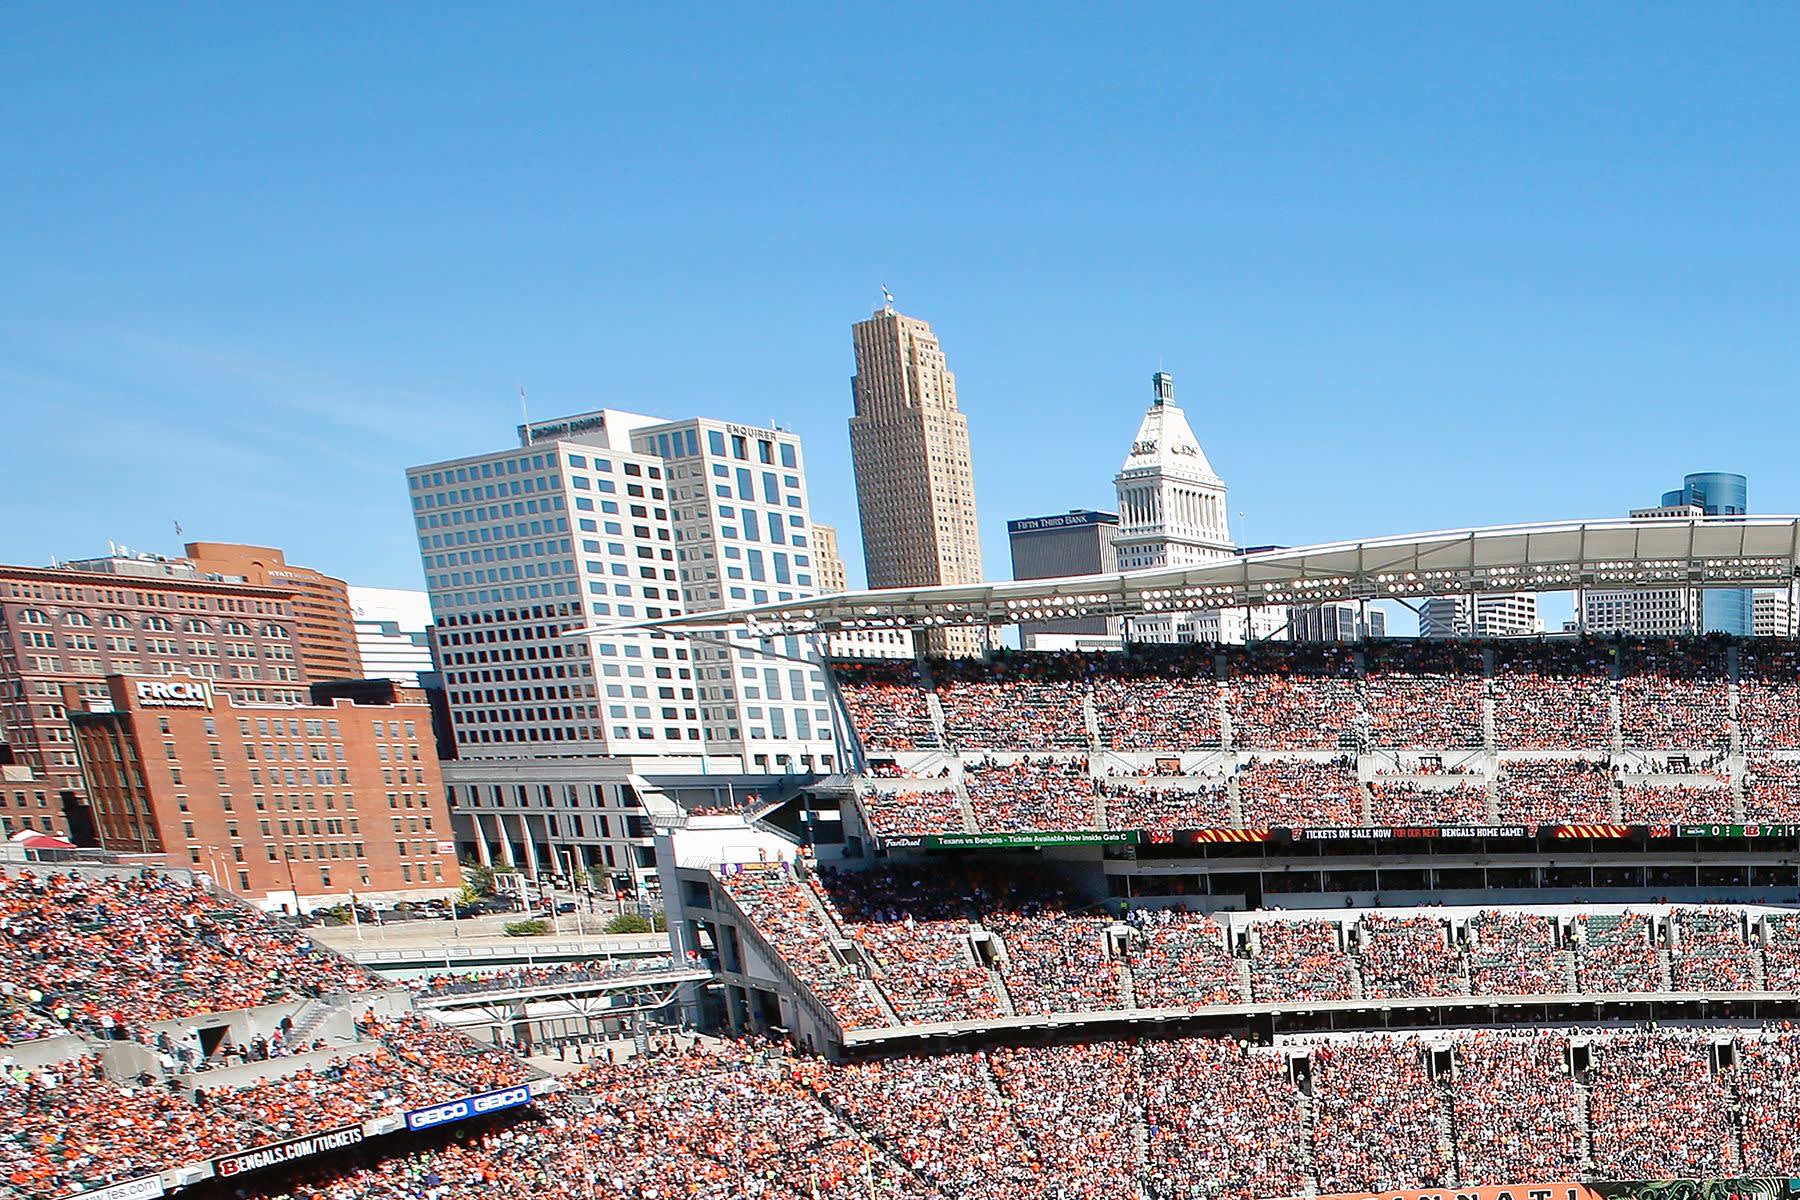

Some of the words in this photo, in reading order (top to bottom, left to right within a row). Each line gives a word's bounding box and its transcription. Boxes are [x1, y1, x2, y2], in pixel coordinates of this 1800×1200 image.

[726, 424, 777, 441] ENQUIRER
[1040, 517, 1064, 528] THIRD
[1065, 515, 1088, 525] BANK
[135, 681, 204, 699] FRCH
[1305, 829, 1337, 840] TICKETS
[1338, 829, 1350, 839] ON
[1351, 828, 1372, 839] SALE
[1373, 828, 1391, 839] NOW
[1441, 828, 1475, 838] BENGALS
[1477, 828, 1499, 838] HOME
[1500, 827, 1524, 837] GAME!
[1711, 825, 1720, 837] 0
[1765, 825, 1773, 837] 7
[884, 838, 921, 848] FanDuel
[938, 837, 963, 845] Texans
[974, 836, 1003, 846] Bengals
[1008, 835, 1032, 844] Tickets
[1034, 834, 1065, 843] Available
[1066, 834, 1081, 842] Now
[1082, 833, 1102, 842] Inside
[1103, 833, 1119, 841] Gate
[1120, 833, 1127, 841] C
[410, 1101, 467, 1127] GEICO
[473, 1088, 527, 1113] GEICO
[219, 1128, 363, 1178] BENGALS.COM/TICKETS
